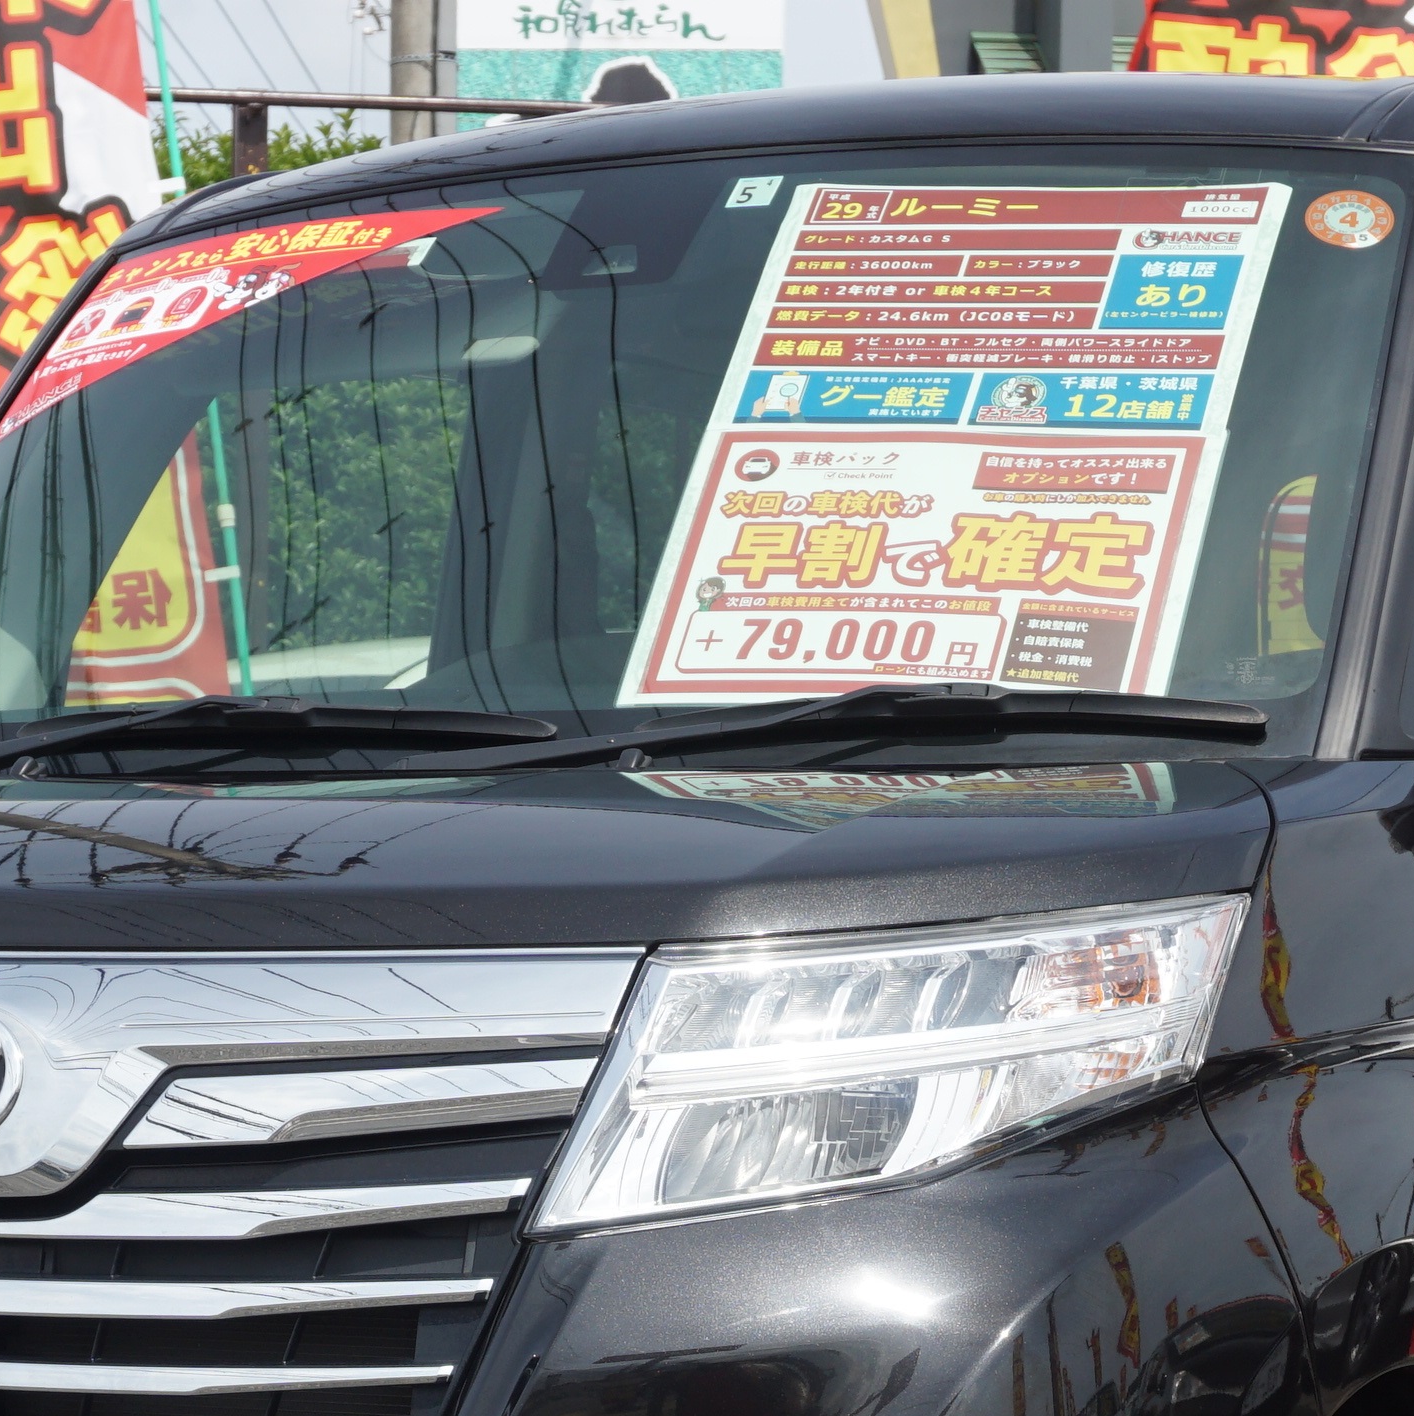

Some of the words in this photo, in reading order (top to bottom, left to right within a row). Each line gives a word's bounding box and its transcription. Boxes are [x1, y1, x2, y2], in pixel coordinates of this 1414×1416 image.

[736, 186, 757, 203] 5
[821, 202, 863, 219] 29
[890, 198, 1039, 217] ルーミー
[1190, 205, 1250, 214] 1000cc
[1339, 211, 1359, 228] 4
[1141, 261, 1217, 277] 修復歴
[905, 286, 926, 296] or
[1136, 284, 1207, 307] あり
[771, 340, 844, 357] 装備品
[820, 385, 950, 407] グー鑑定
[1064, 394, 1174, 419] 12店舗
[1177, 394, 1194, 421] 営業中
[791, 451, 900, 466] 車検パック
[986, 456, 1168, 469] 自信を持ってオススメ出来る
[721, 490, 934, 518] 次回の車検代が
[719, 511, 1154, 598] 早割で確定
